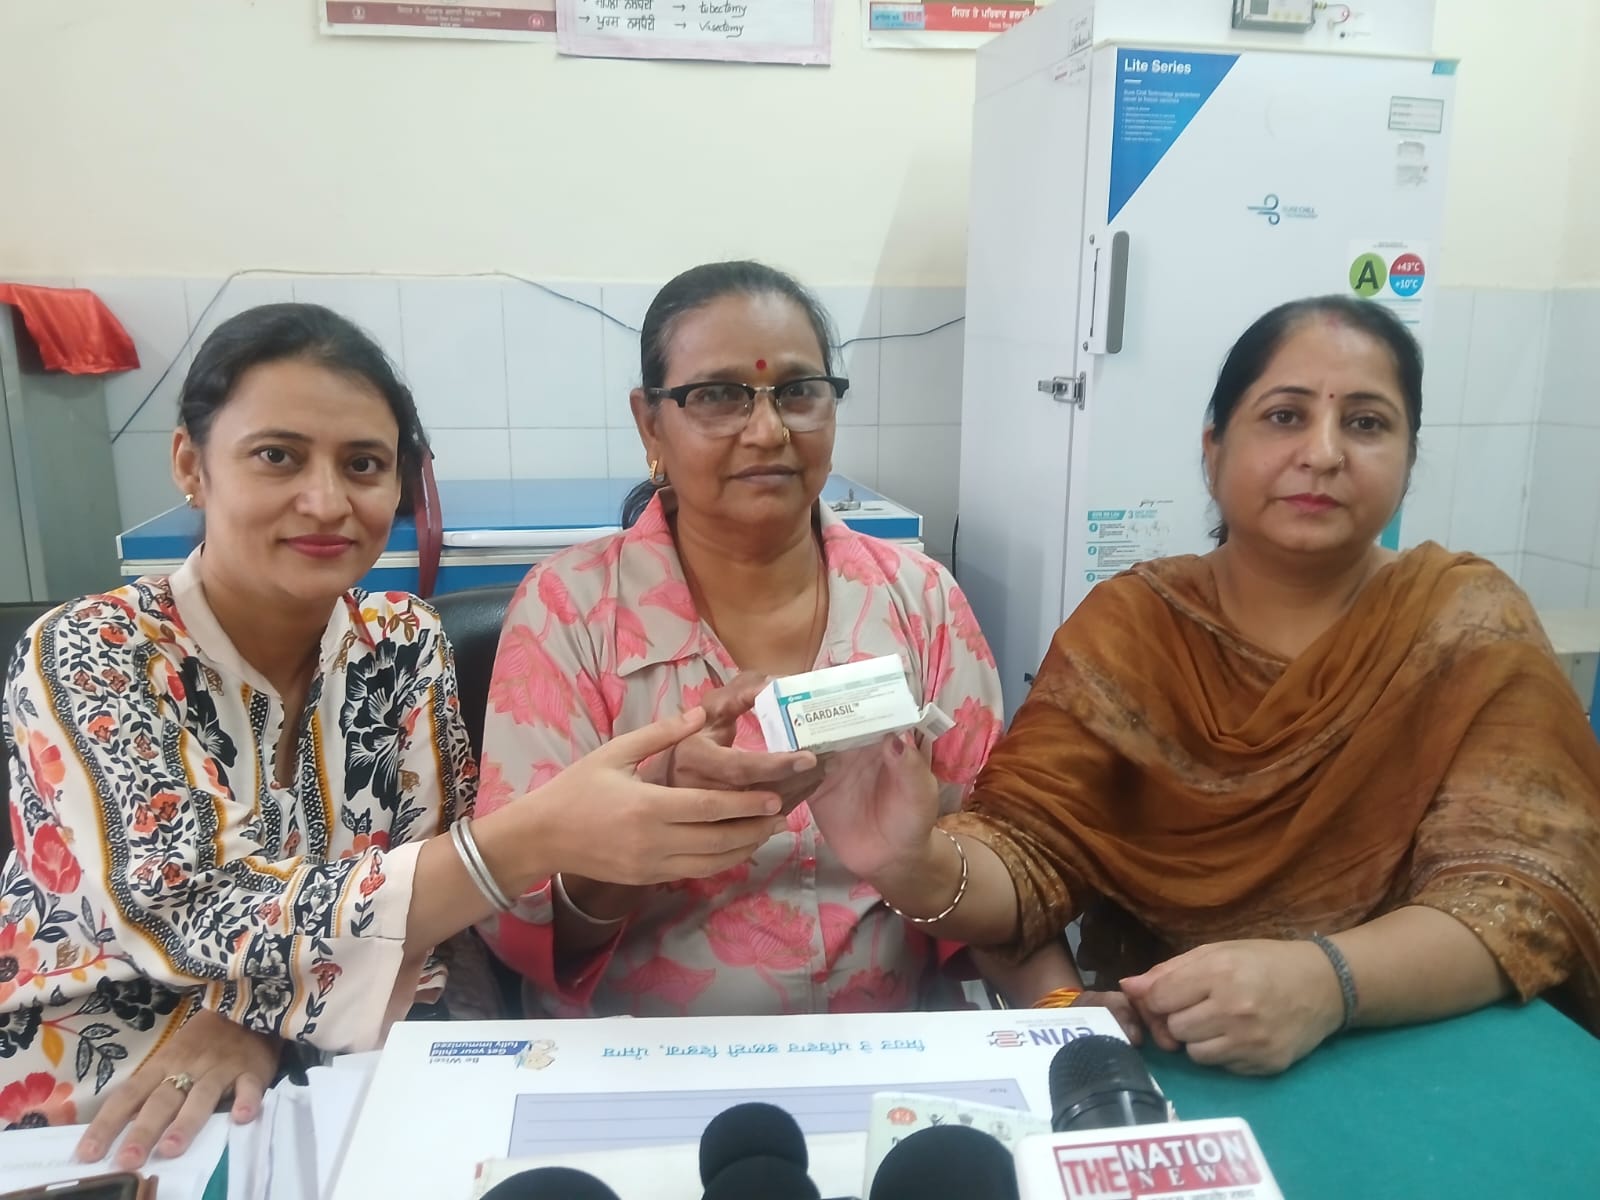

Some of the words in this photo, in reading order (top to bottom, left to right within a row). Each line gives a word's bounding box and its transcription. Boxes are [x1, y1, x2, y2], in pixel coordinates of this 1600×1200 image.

[1124, 58, 1149, 73] Lite
[1152, 59, 1192, 75] Series
[1354, 259, 1380, 290] A
[431, 1048, 458, 1056] child
[459, 1047, 485, 1056] your
[495, 1040, 519, 1049] fully
[1120, 1135, 1247, 1171] NATION
[1062, 1156, 1130, 1196] THE
